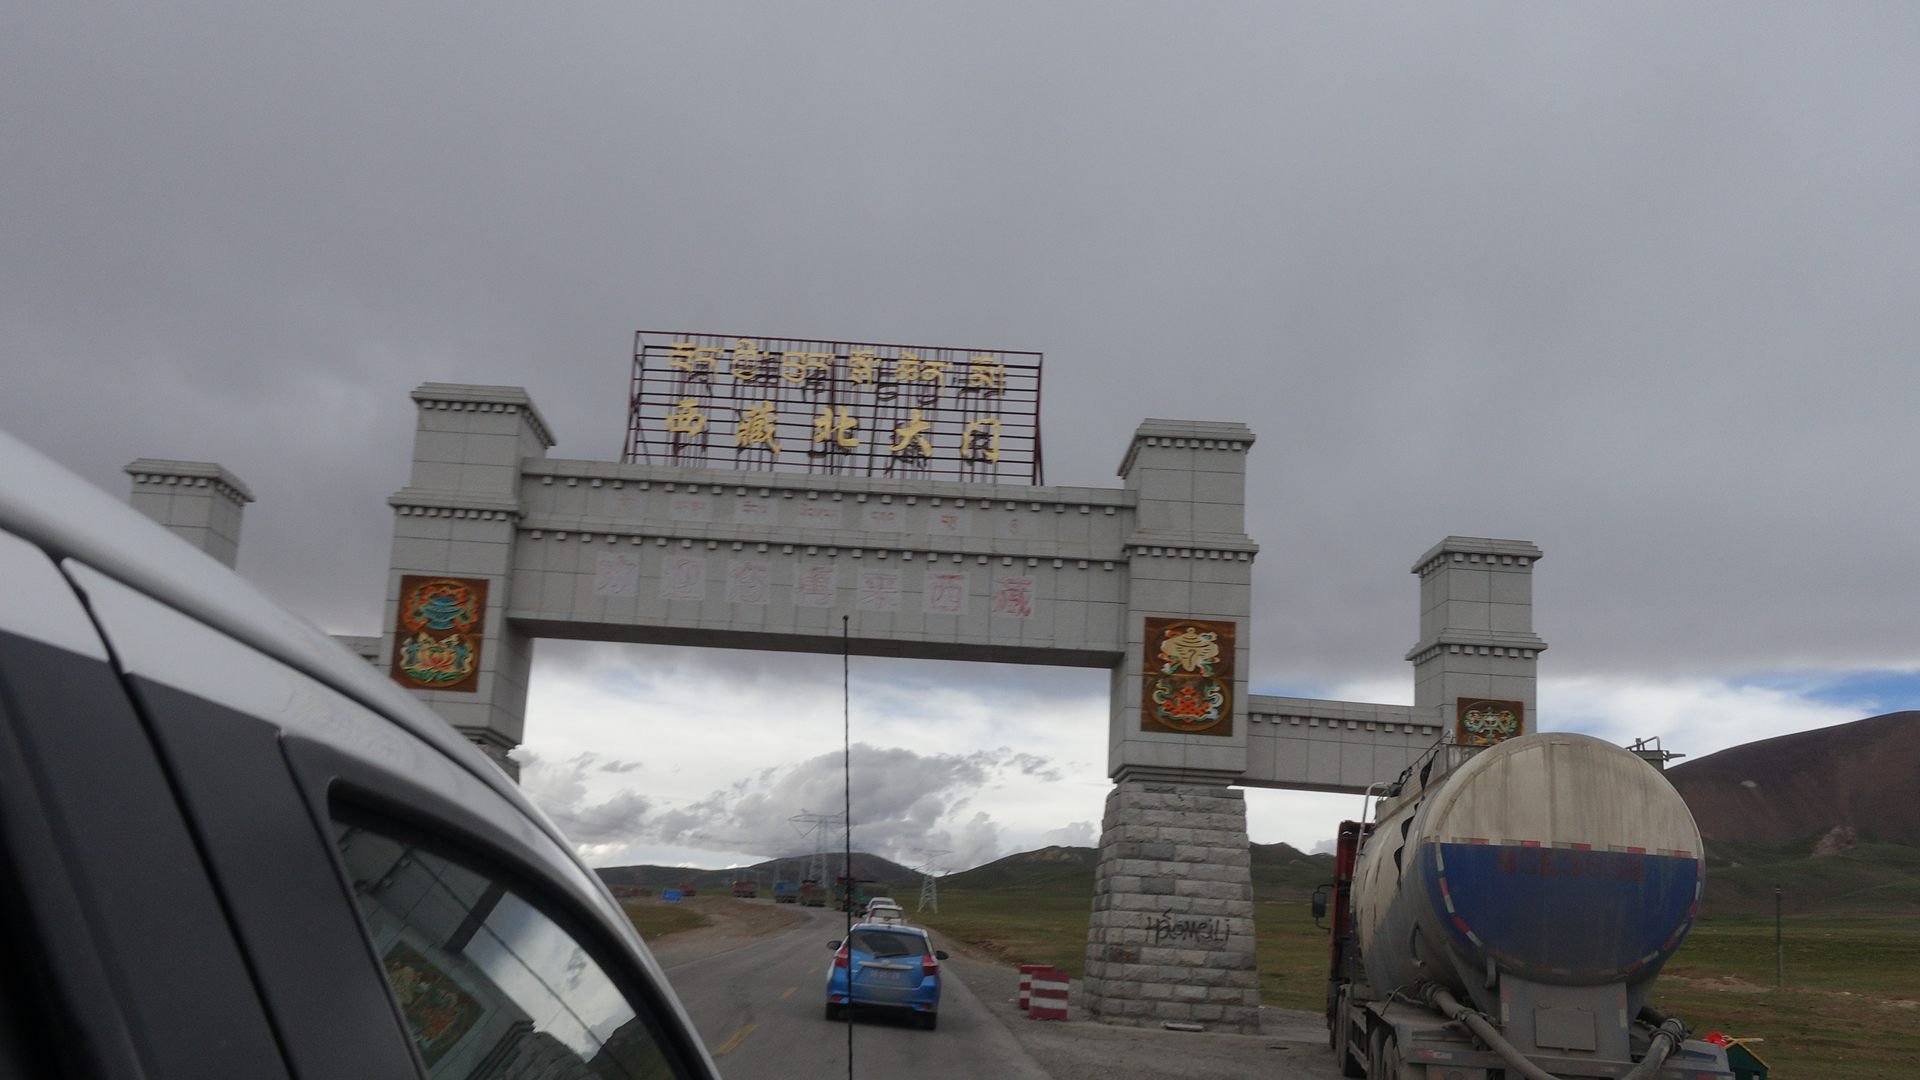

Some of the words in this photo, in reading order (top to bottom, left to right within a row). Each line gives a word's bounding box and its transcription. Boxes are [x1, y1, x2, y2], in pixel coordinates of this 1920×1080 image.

[666, 399, 1001, 463] 西藏北大门
